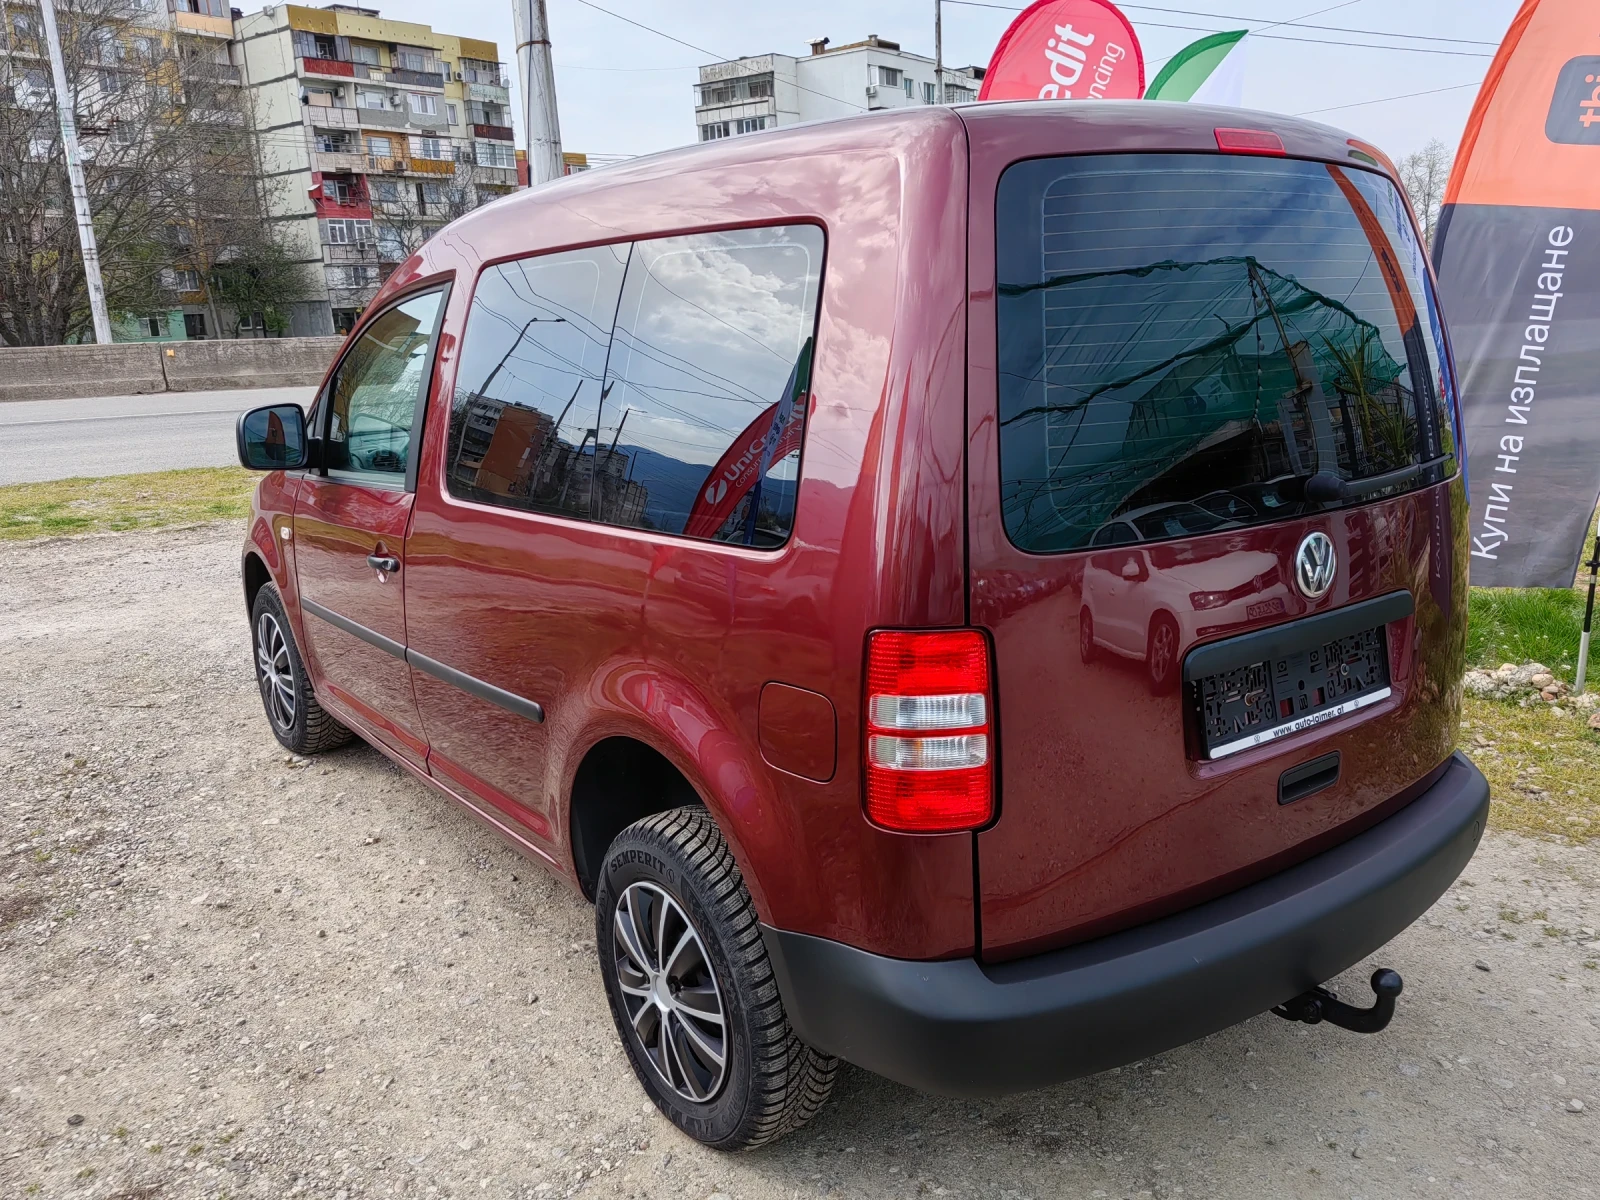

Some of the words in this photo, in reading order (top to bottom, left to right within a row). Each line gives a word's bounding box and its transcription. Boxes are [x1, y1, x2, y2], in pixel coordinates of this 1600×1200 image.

[1087, 42, 1126, 99] ncing
[1505, 225, 1574, 425] изплащане
[1495, 435, 1525, 473] на
[1471, 483, 1513, 560] Купи
[610, 850, 666, 875] SEMPERIT
